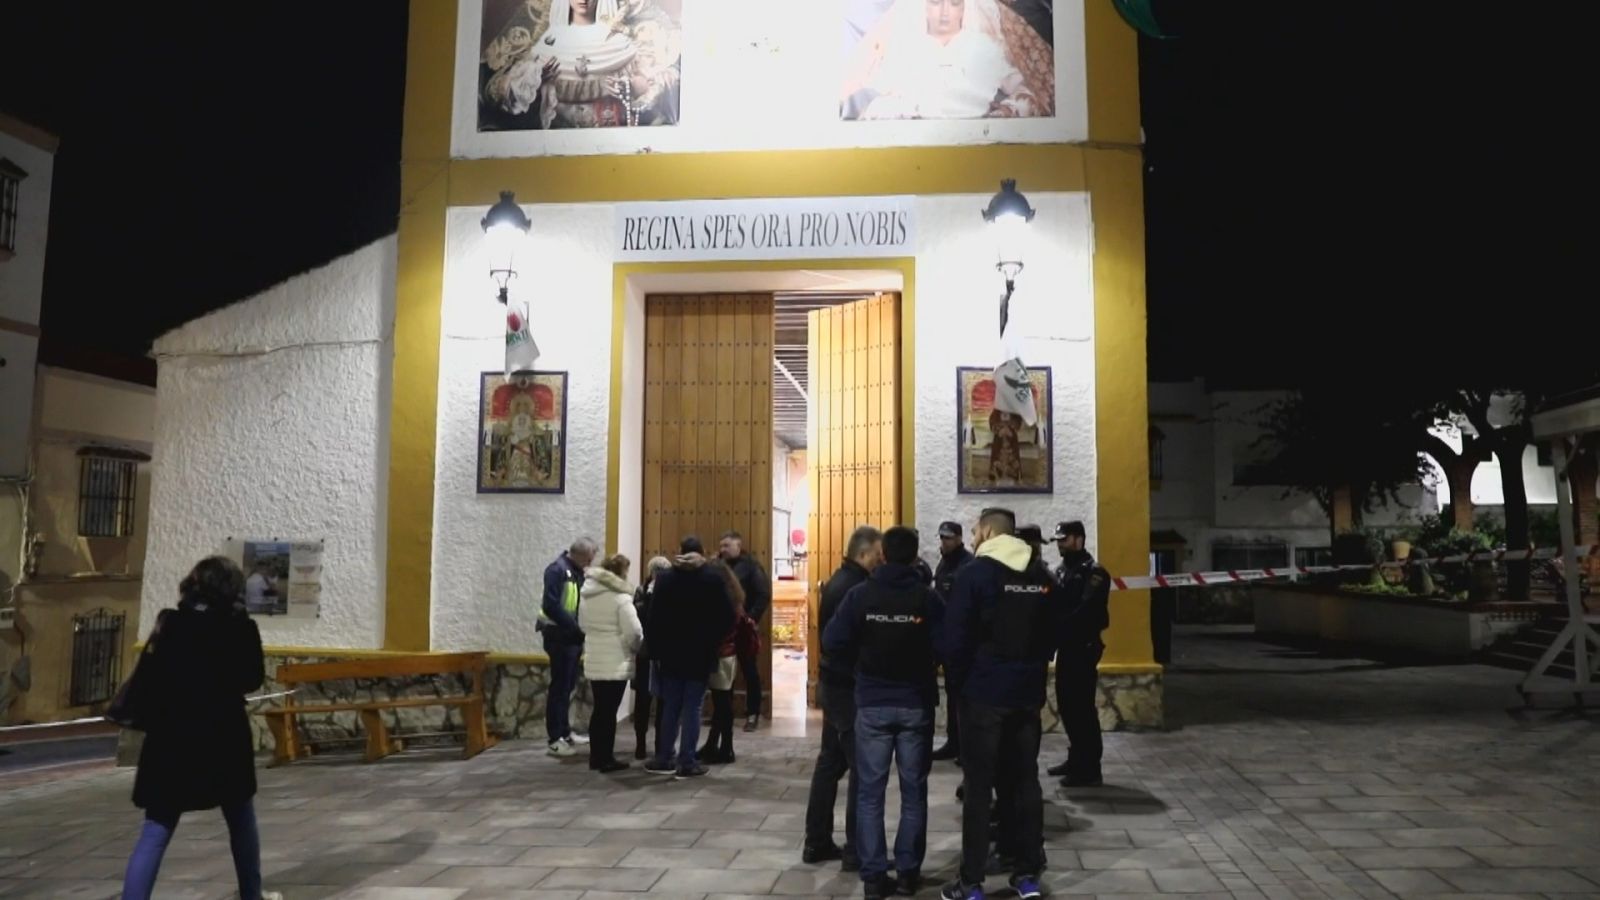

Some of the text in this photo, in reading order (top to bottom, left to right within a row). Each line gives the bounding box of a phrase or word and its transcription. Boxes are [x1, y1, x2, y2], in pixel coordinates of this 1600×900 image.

[622, 210, 908, 251] REGINA SPES ORA PRO NOBIS
[1004, 584, 1043, 593] POLICIA
[866, 614, 915, 623] POLICIA
